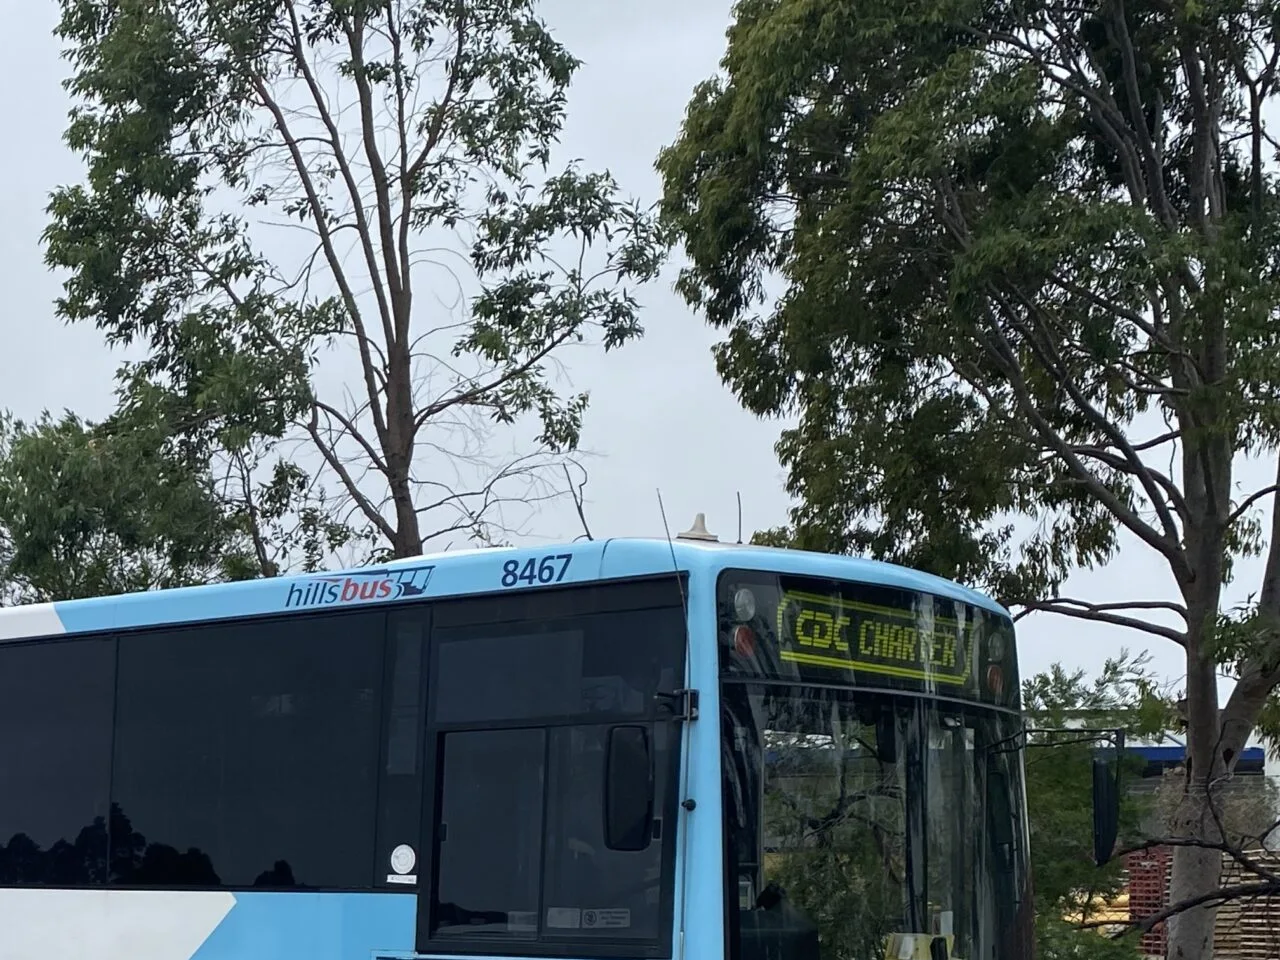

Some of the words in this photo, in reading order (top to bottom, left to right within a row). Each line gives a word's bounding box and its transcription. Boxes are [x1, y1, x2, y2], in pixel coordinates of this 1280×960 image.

[501, 553, 573, 587] 8467
[285, 577, 394, 607] hillsbus
[795, 609, 851, 651] CDC
